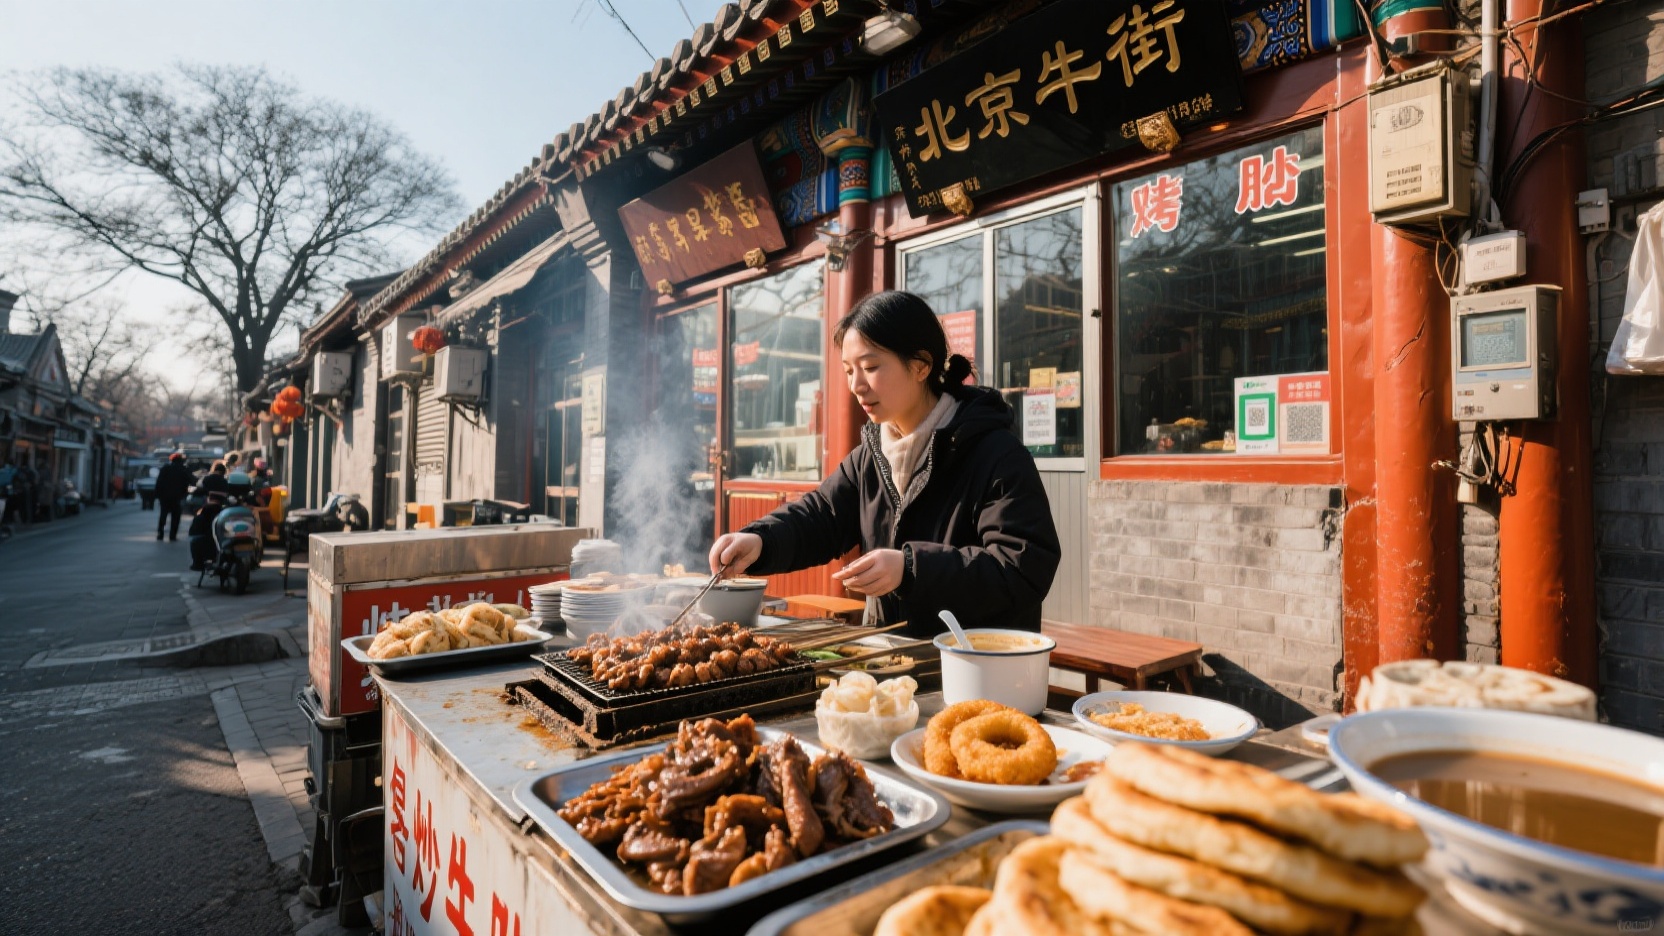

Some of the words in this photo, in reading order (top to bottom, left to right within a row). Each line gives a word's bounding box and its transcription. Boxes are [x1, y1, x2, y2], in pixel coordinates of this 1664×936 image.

[915, 0, 1186, 162] 北京牛街
[1130, 174, 1183, 239] 烤
